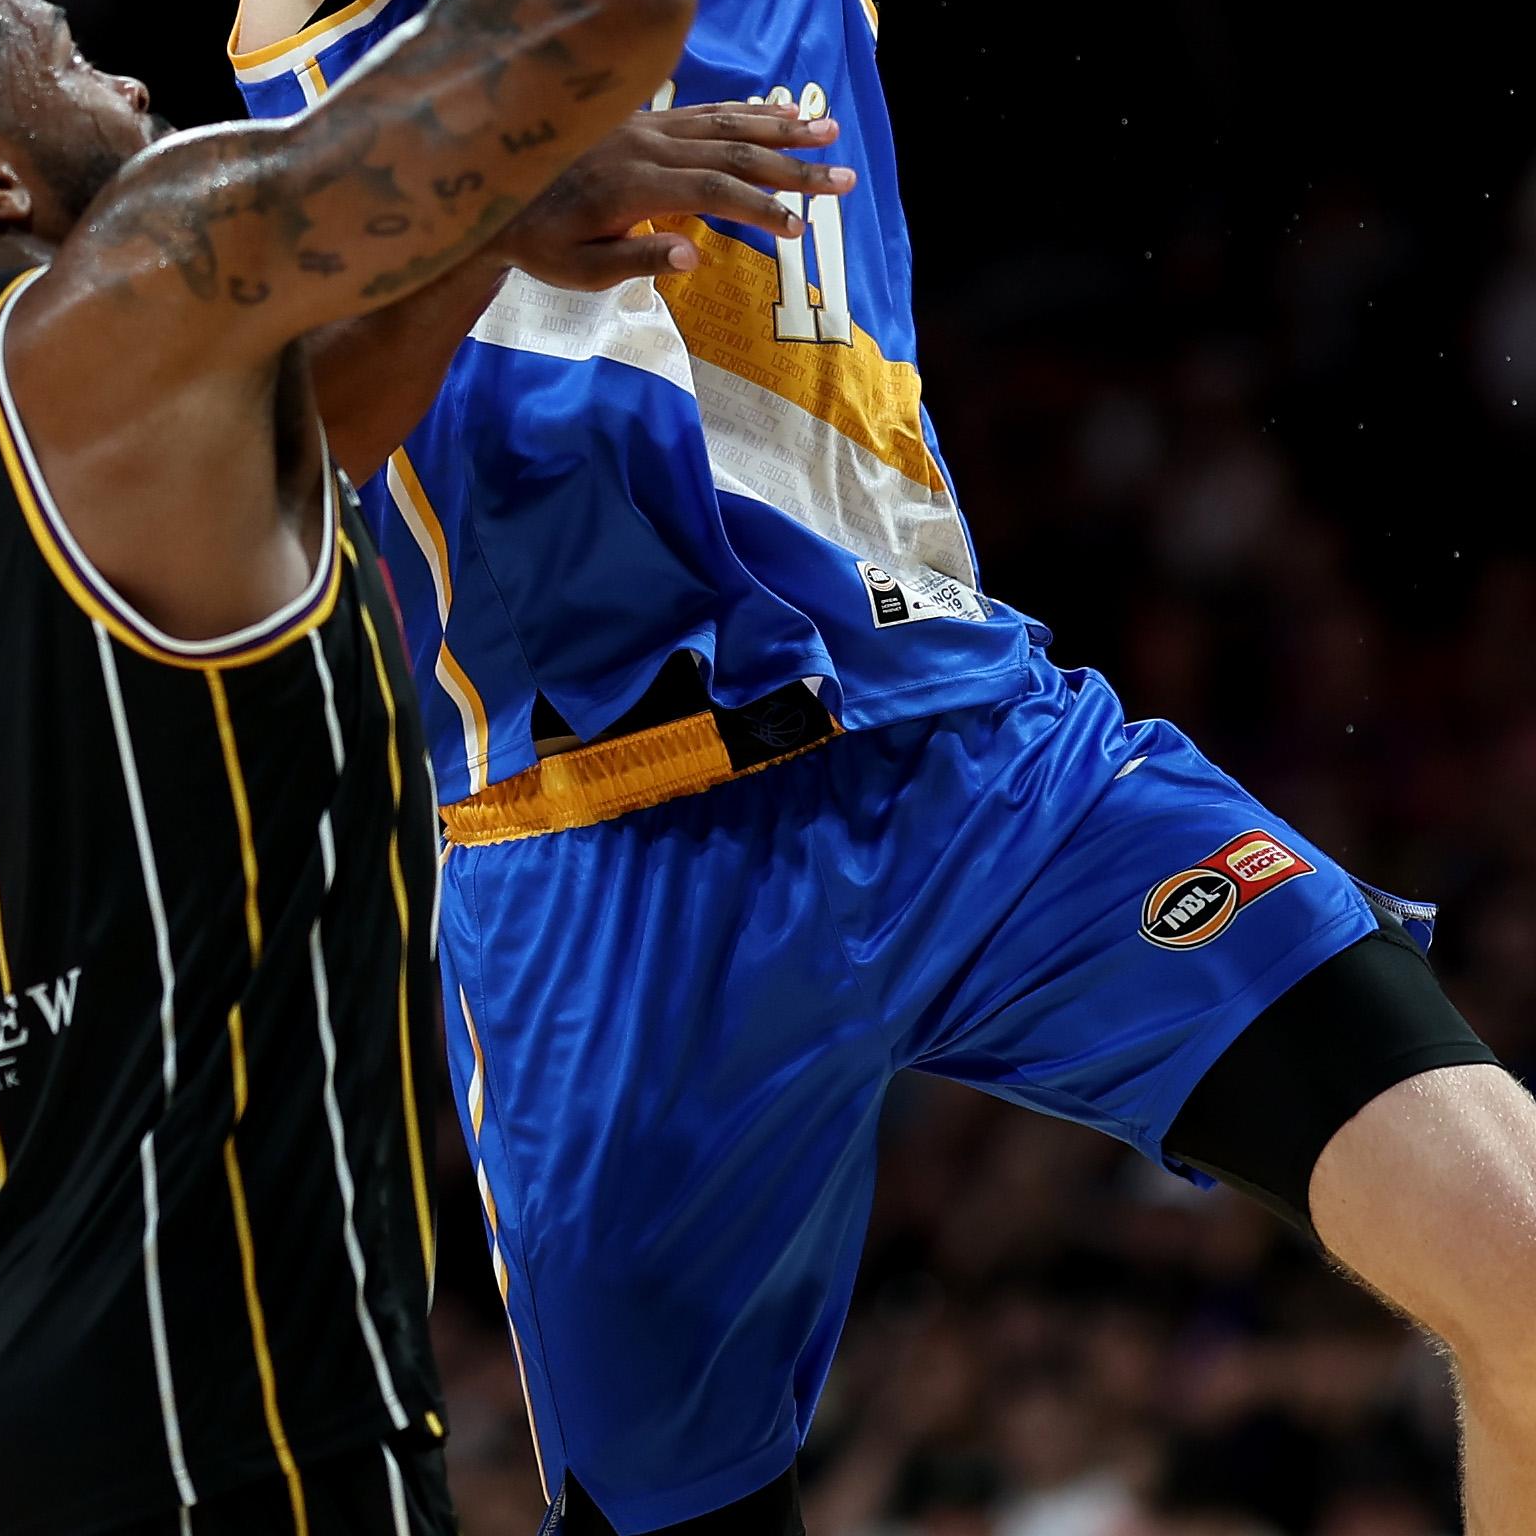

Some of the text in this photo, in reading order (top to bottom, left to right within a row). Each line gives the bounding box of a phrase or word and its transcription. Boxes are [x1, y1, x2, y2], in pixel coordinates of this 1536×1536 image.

[773, 190, 853, 346] 11
[707, 437, 753, 467] URRAY
[1162, 885, 1222, 932] NBL
